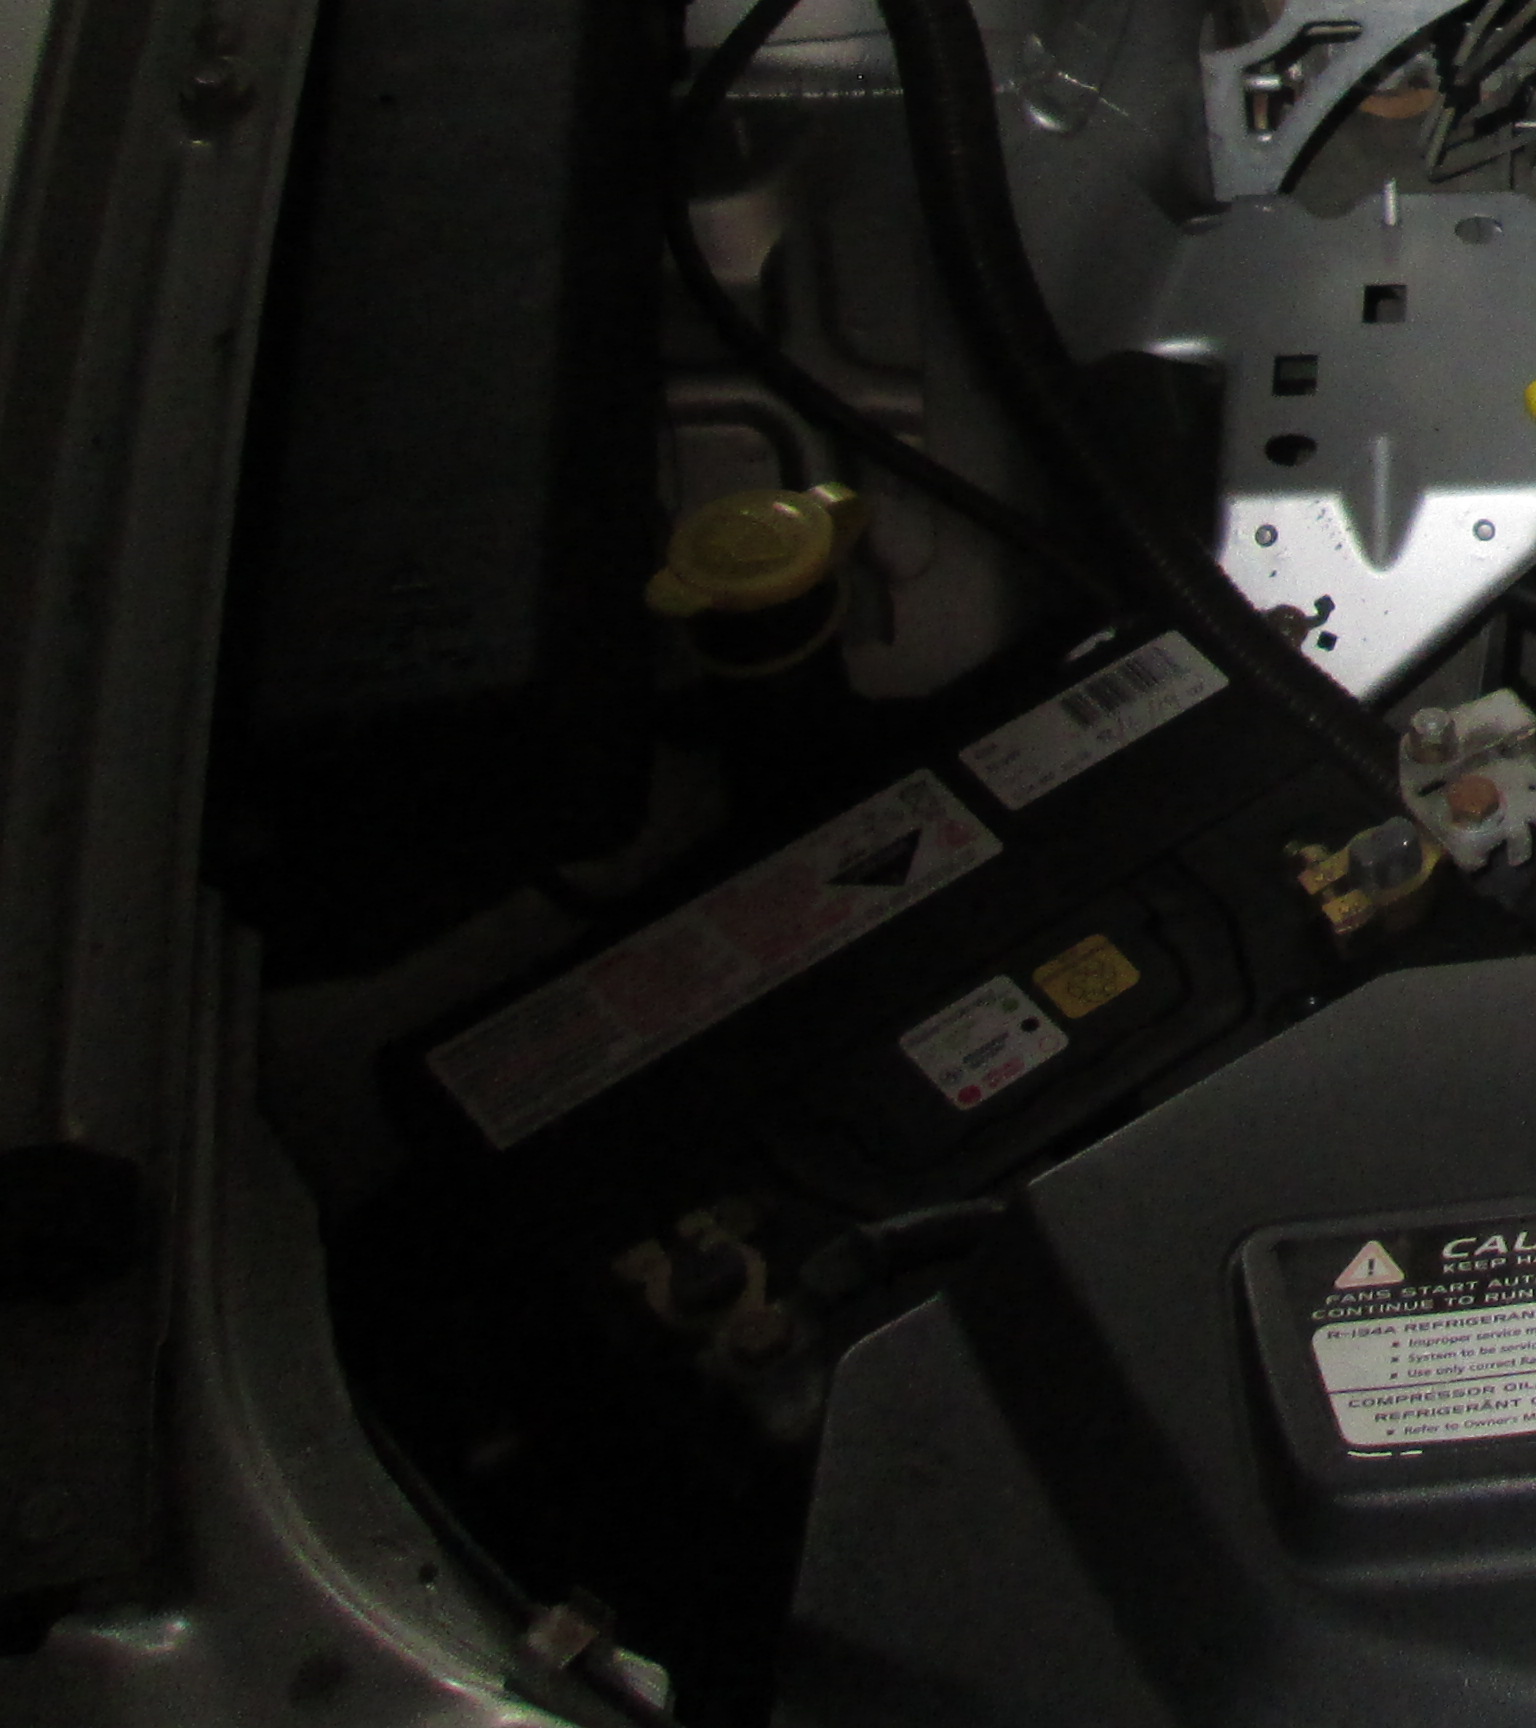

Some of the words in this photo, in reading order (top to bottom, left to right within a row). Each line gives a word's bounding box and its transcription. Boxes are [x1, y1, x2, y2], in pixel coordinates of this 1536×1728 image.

[1443, 1257, 1507, 1273] KEEP
[1325, 1289, 1391, 1305] FANS
[1401, 1280, 1479, 1296] START
[1312, 1299, 1434, 1320] CONTINUE
[1446, 1295, 1475, 1307] TO
[1485, 1287, 1534, 1303] RUN
[1408, 1333, 1472, 1349] Improper
[1476, 1327, 1522, 1341] service
[1407, 1350, 1457, 1364] System
[1460, 1347, 1476, 1358] to
[1480, 1345, 1496, 1355] be
[1406, 1367, 1433, 1378] Use
[1436, 1363, 1465, 1376] only
[1468, 1358, 1516, 1371] correct
[1348, 1384, 1496, 1409] COMPRESSOR
[1403, 1424, 1441, 1437] Refer
[1444, 1421, 1459, 1432] to
